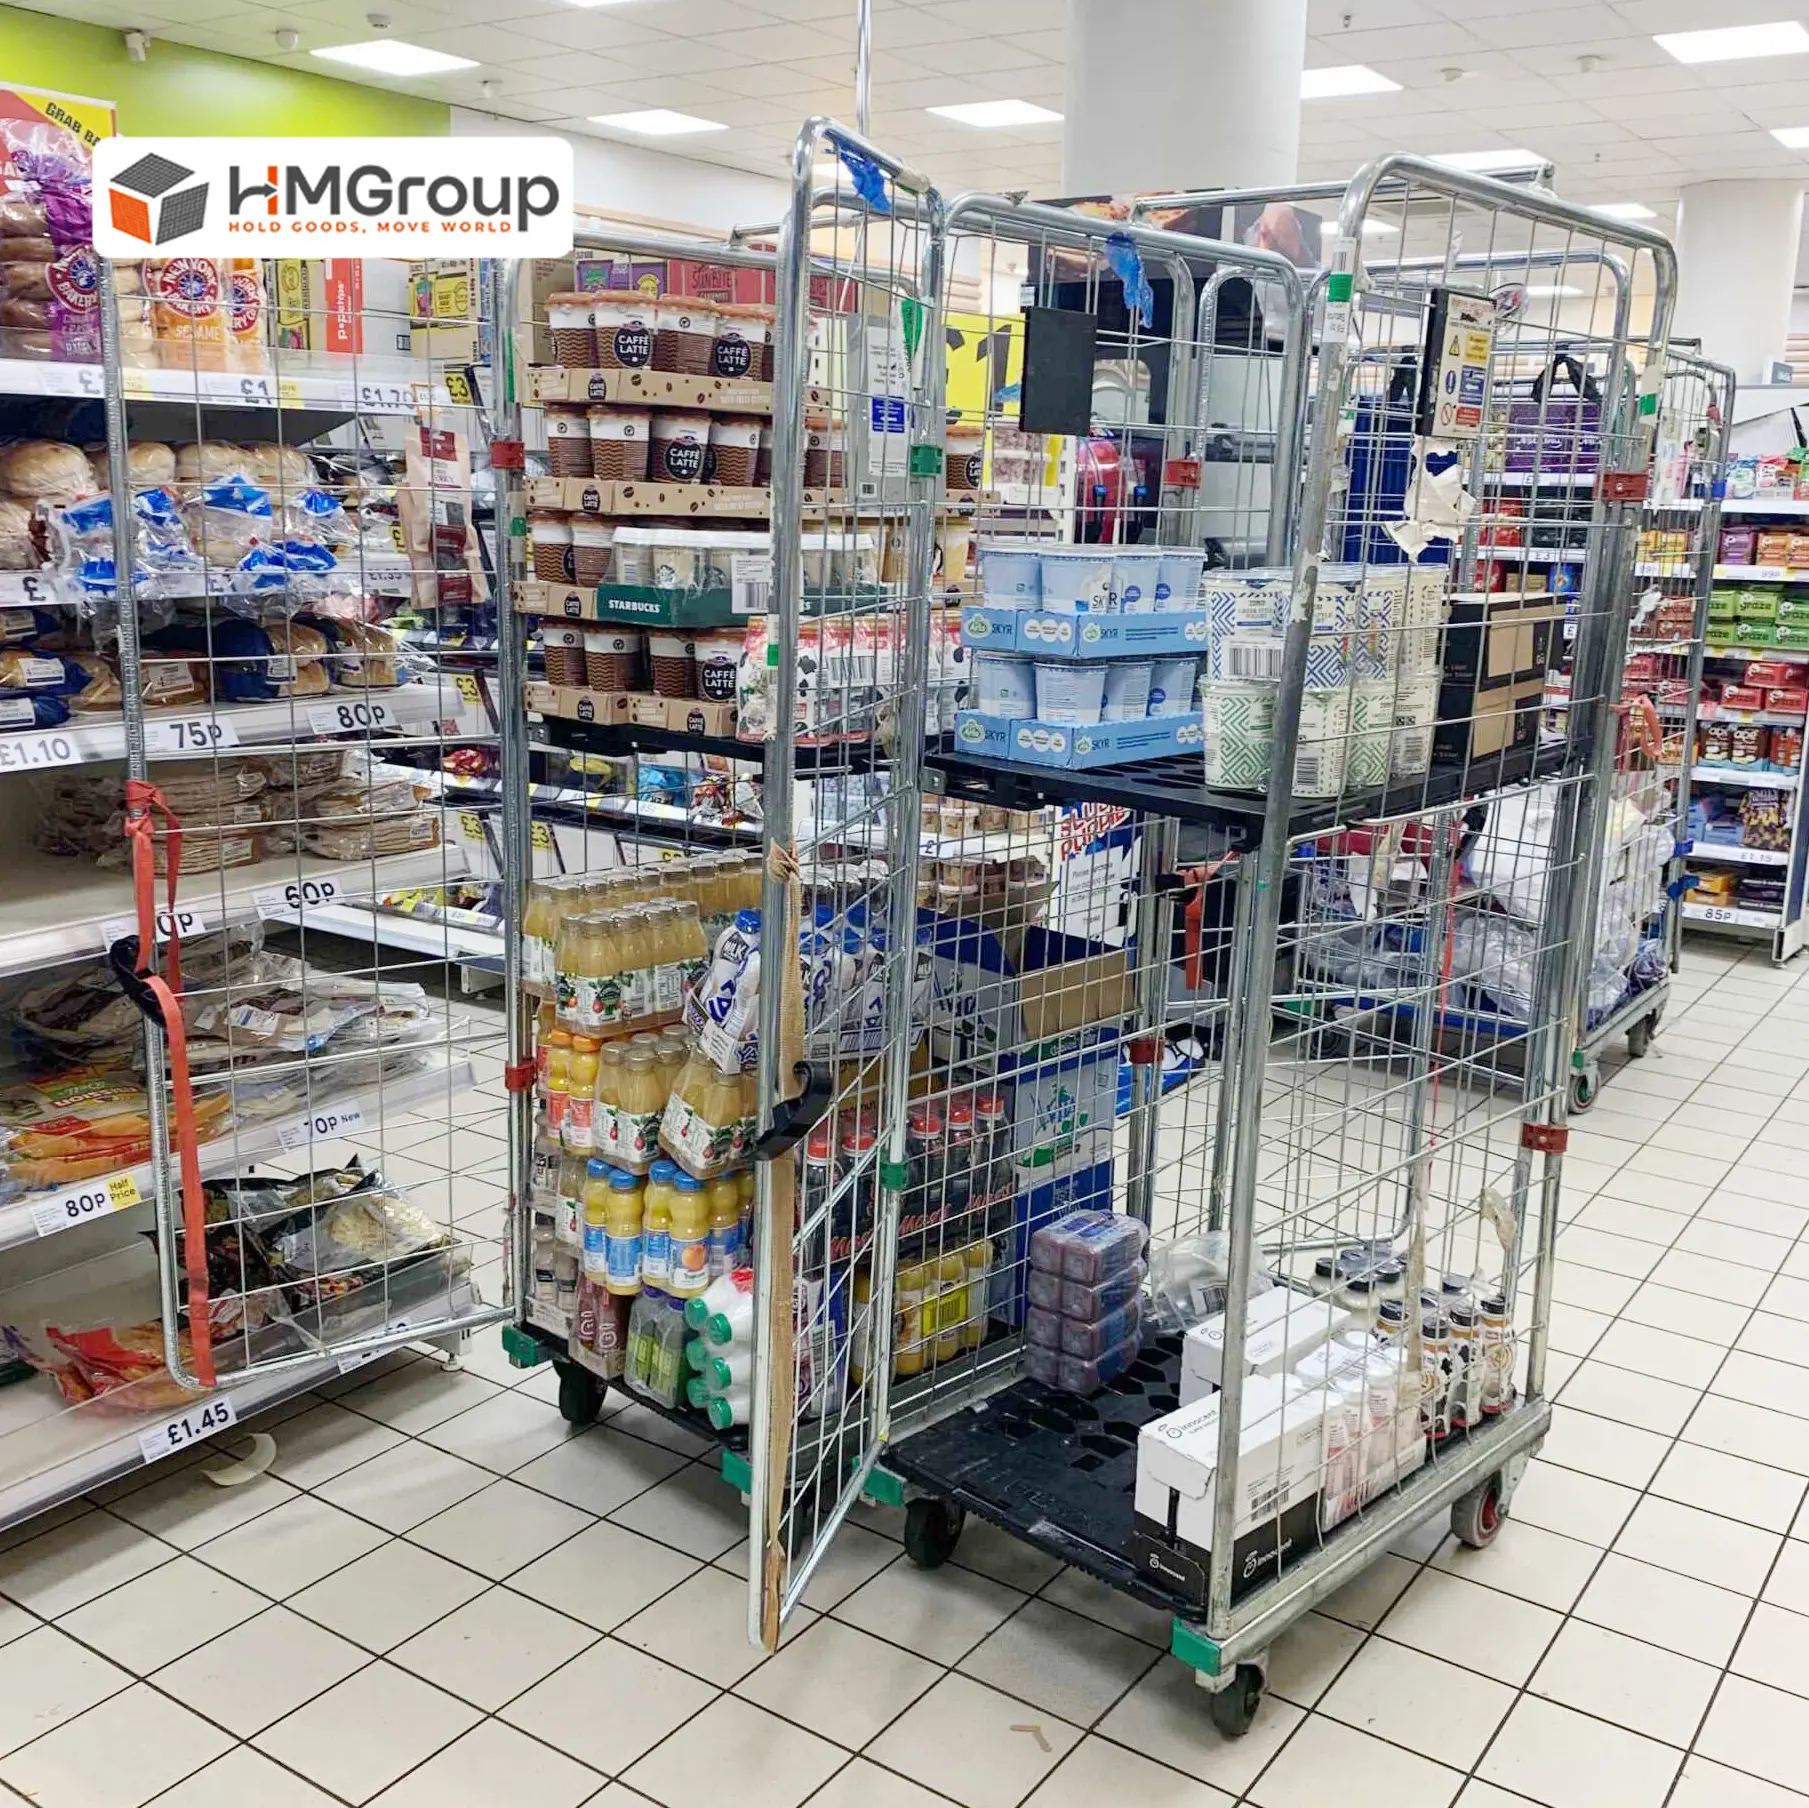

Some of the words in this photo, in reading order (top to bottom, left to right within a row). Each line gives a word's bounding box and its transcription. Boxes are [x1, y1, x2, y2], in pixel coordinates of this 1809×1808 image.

[45, 102, 82, 133] GRAB
[620, 344, 649, 356] LATTE
[718, 355, 747, 367] LATTE
[445, 376, 469, 398] £3
[670, 457, 699, 470] LATTE
[608, 599, 660, 613] STARBUCKS
[991, 624, 1012, 634] SKYR
[455, 676, 479, 698] £3
[705, 679, 736, 690] LATTE
[337, 703, 386, 729] 80p
[170, 722, 222, 749] 75p
[984, 730, 1007, 743] SKYR
[0, 737, 71, 768] £1.10
[460, 815, 484, 839] £3
[285, 881, 335, 908] 60p
[1705, 908, 1732, 920] 85p
[722, 941, 748, 960] MILK
[341, 1110, 361, 1125] New
[109, 1178, 130, 1192] Half
[65, 1190, 106, 1219] 80p
[109, 1189, 137, 1205] Price
[167, 1402, 230, 1446] £1.45
[1180, 1408, 1218, 1431] innocent
